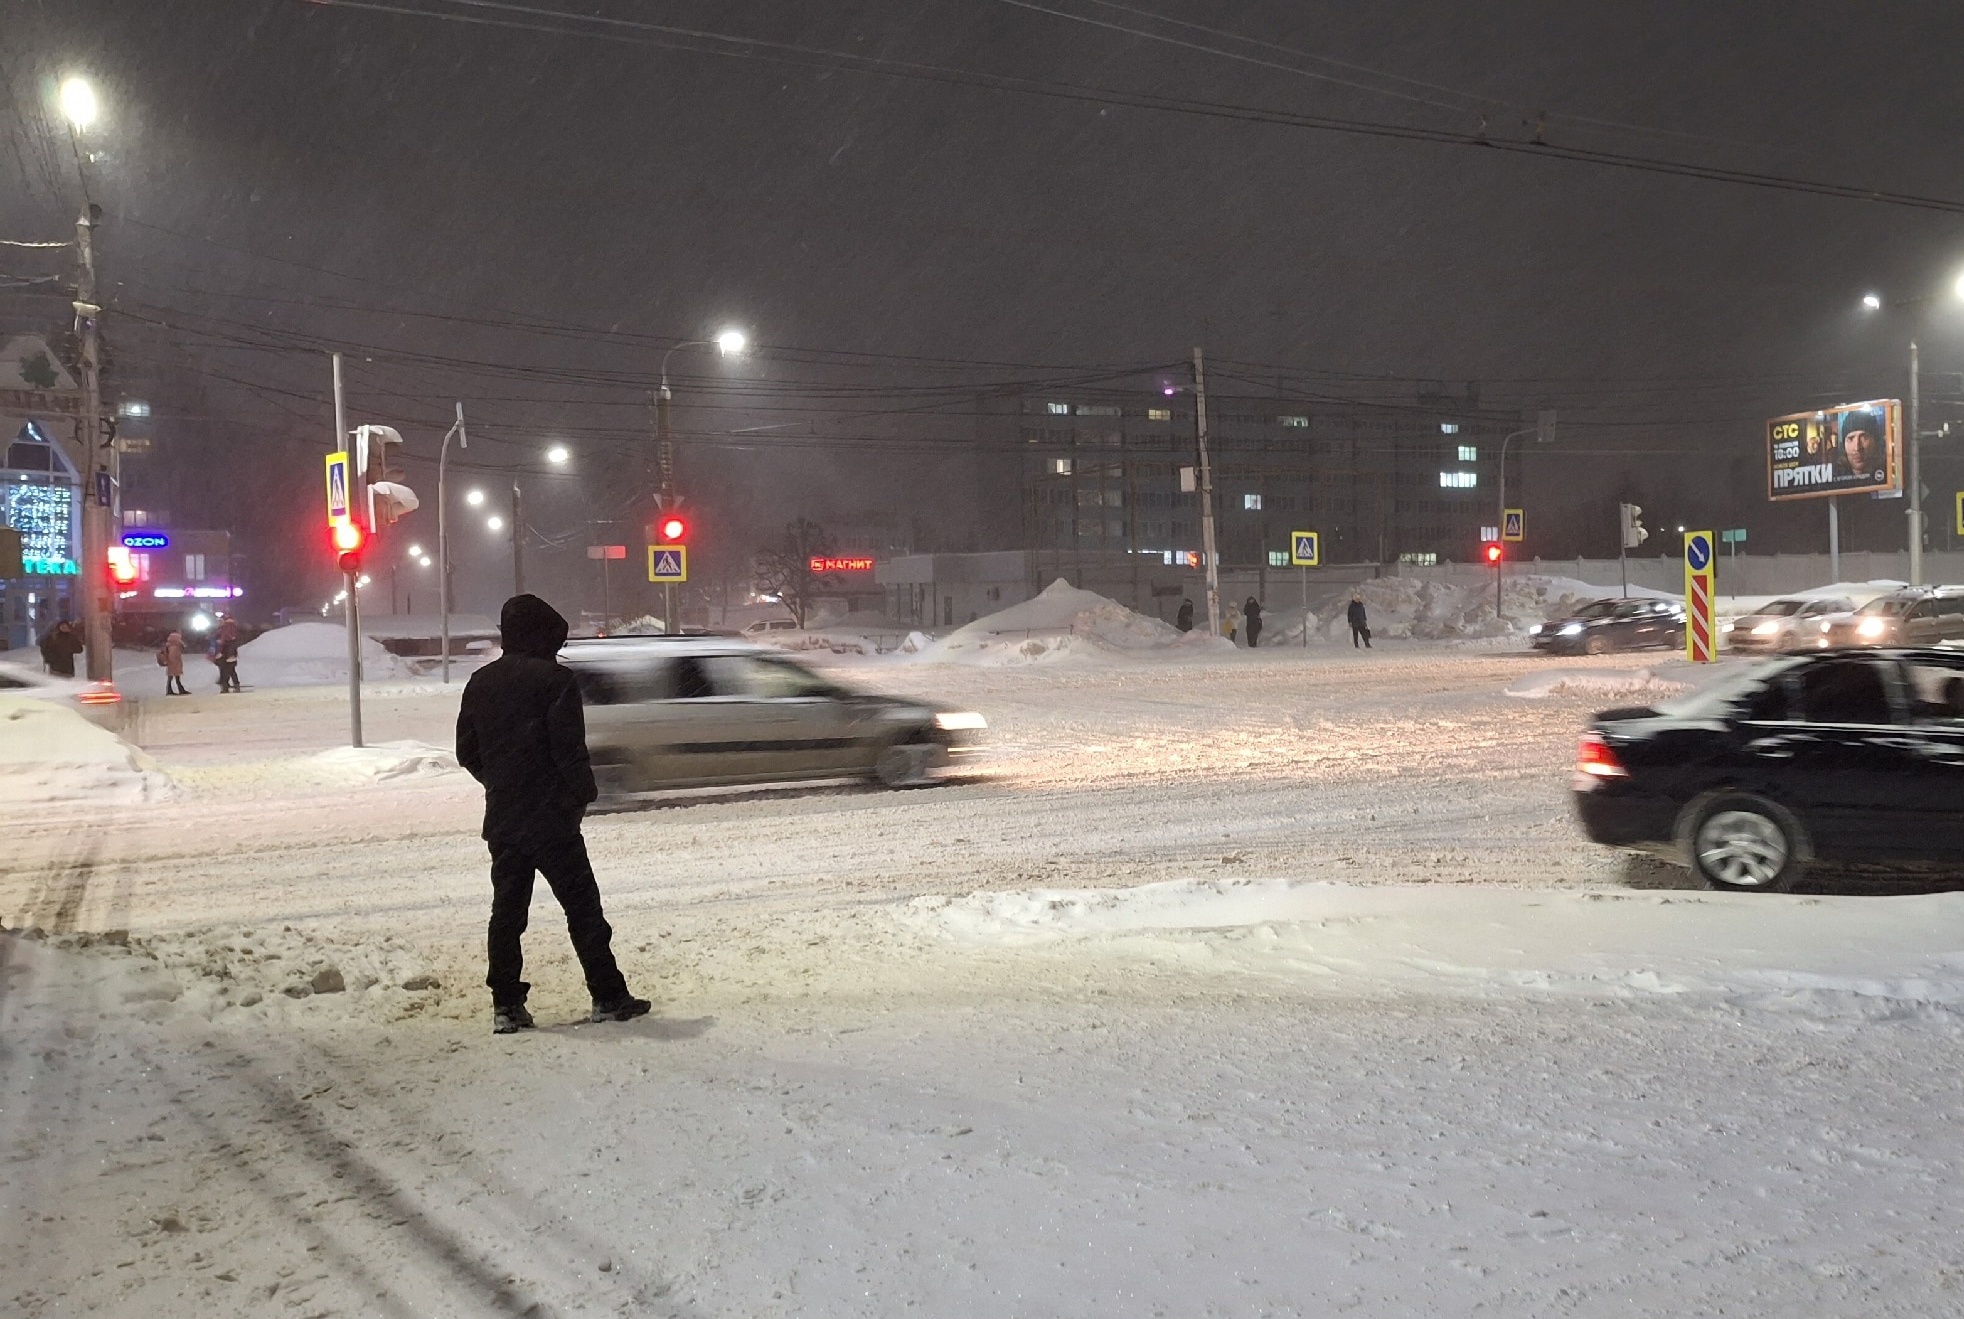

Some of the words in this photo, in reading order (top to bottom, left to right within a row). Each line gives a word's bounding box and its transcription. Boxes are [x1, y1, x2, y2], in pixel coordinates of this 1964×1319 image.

[1773, 424, 1798, 439] СТС
[1773, 463, 1832, 488] ПРЯТКИ
[124, 537, 165, 547] OZON
[825, 560, 873, 570] МАГНИТ
